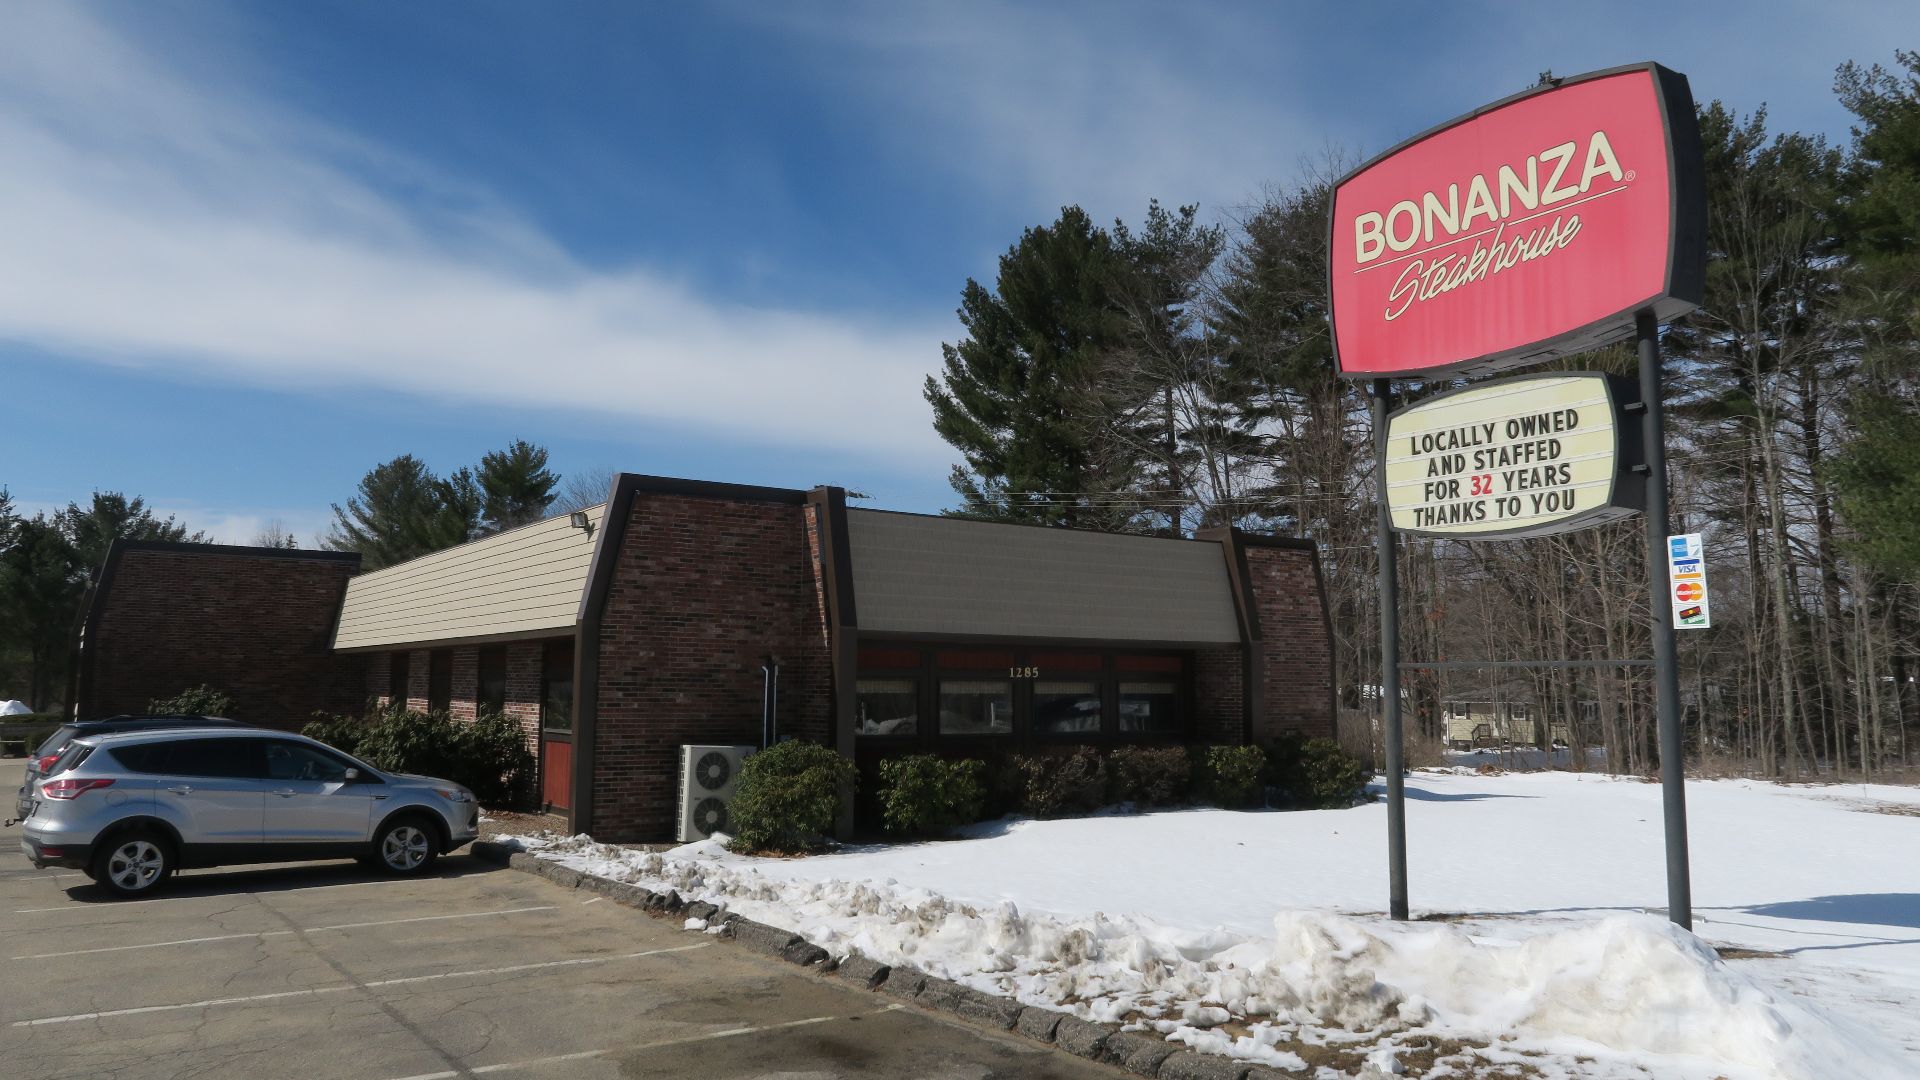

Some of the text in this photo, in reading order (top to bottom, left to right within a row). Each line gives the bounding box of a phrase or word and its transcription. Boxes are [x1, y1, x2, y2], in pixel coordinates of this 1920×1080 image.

[1354, 130, 1623, 264] BONANZA
[1384, 213, 1583, 321] Steakhouse
[1410, 408, 1579, 455] LOCALLY OWNED
[1427, 438, 1561, 478] AND STAFFED
[1424, 462, 1571, 502] FOR 32 YEARS
[1413, 488, 1575, 528] THANKS TO YOU
[1678, 564, 1697, 573] VISA
[1009, 666, 1039, 678] 1285
